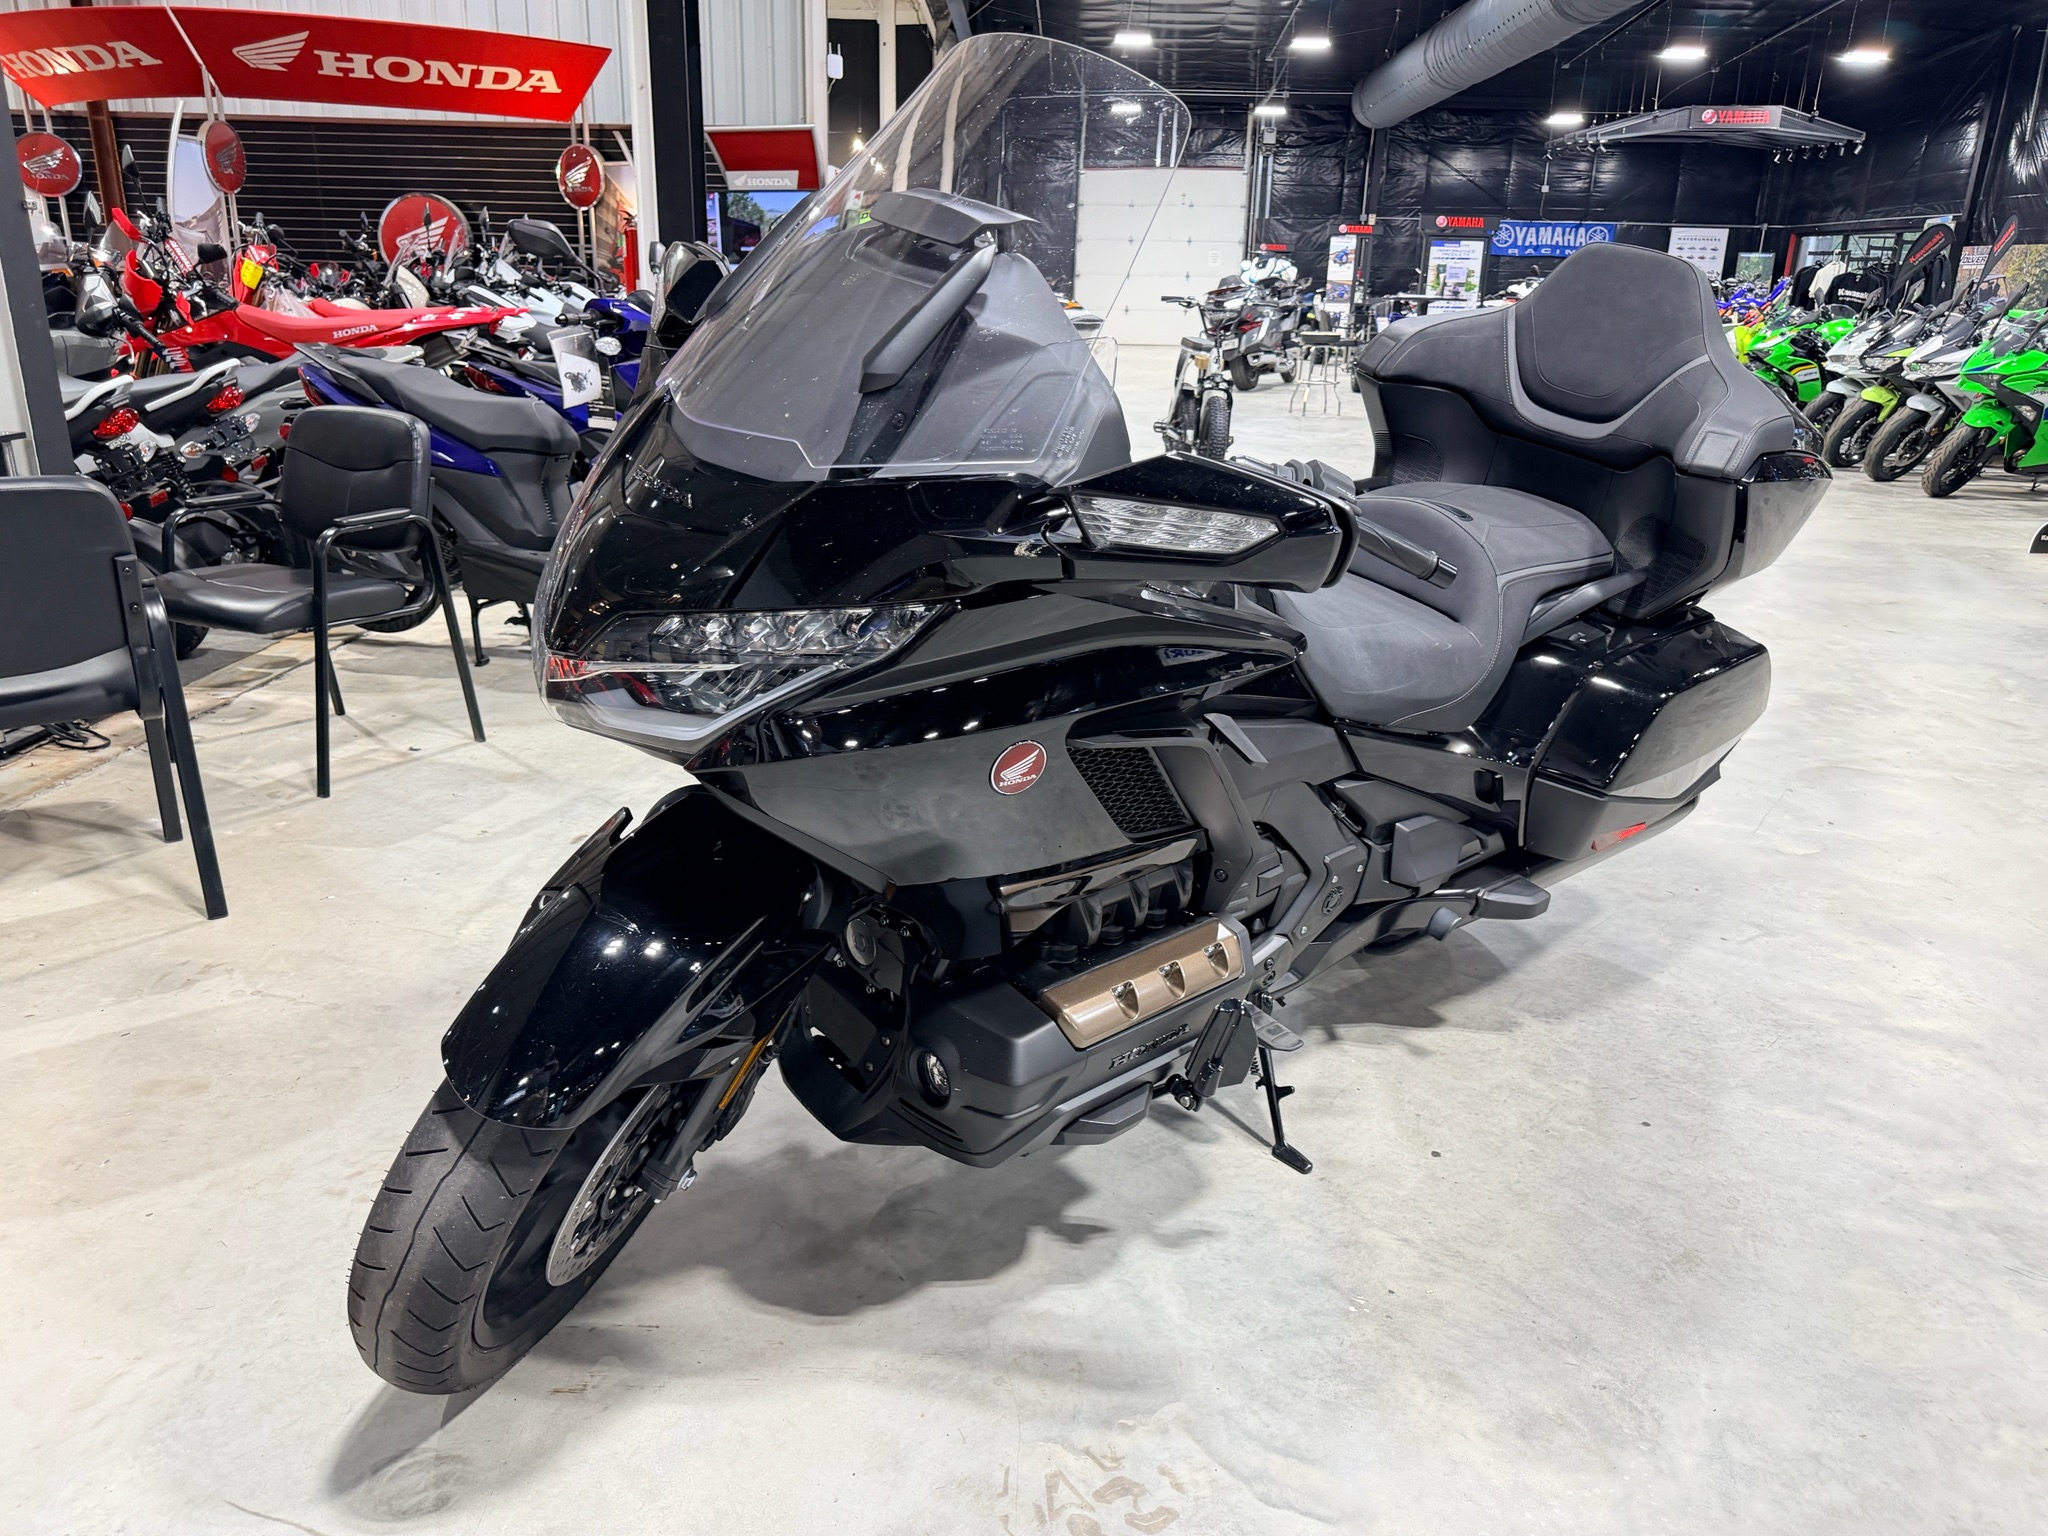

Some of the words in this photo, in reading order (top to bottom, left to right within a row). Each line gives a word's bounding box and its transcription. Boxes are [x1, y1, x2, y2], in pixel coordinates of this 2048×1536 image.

[1, 41, 163, 79] HONDA
[313, 49, 563, 94] HONDA
[1718, 110, 1770, 124] YAMAHA
[747, 177, 792, 187] HONDA
[1447, 216, 1485, 228] YAMAHA
[1346, 225, 1373, 234] YAMAHA
[1514, 226, 1588, 247] YAMAHA
[1837, 287, 1869, 300] Kawasak
[332, 324, 379, 339] HONDA
[998, 774, 1037, 787] HONDA
[1108, 1023, 1191, 1071] HONDA
